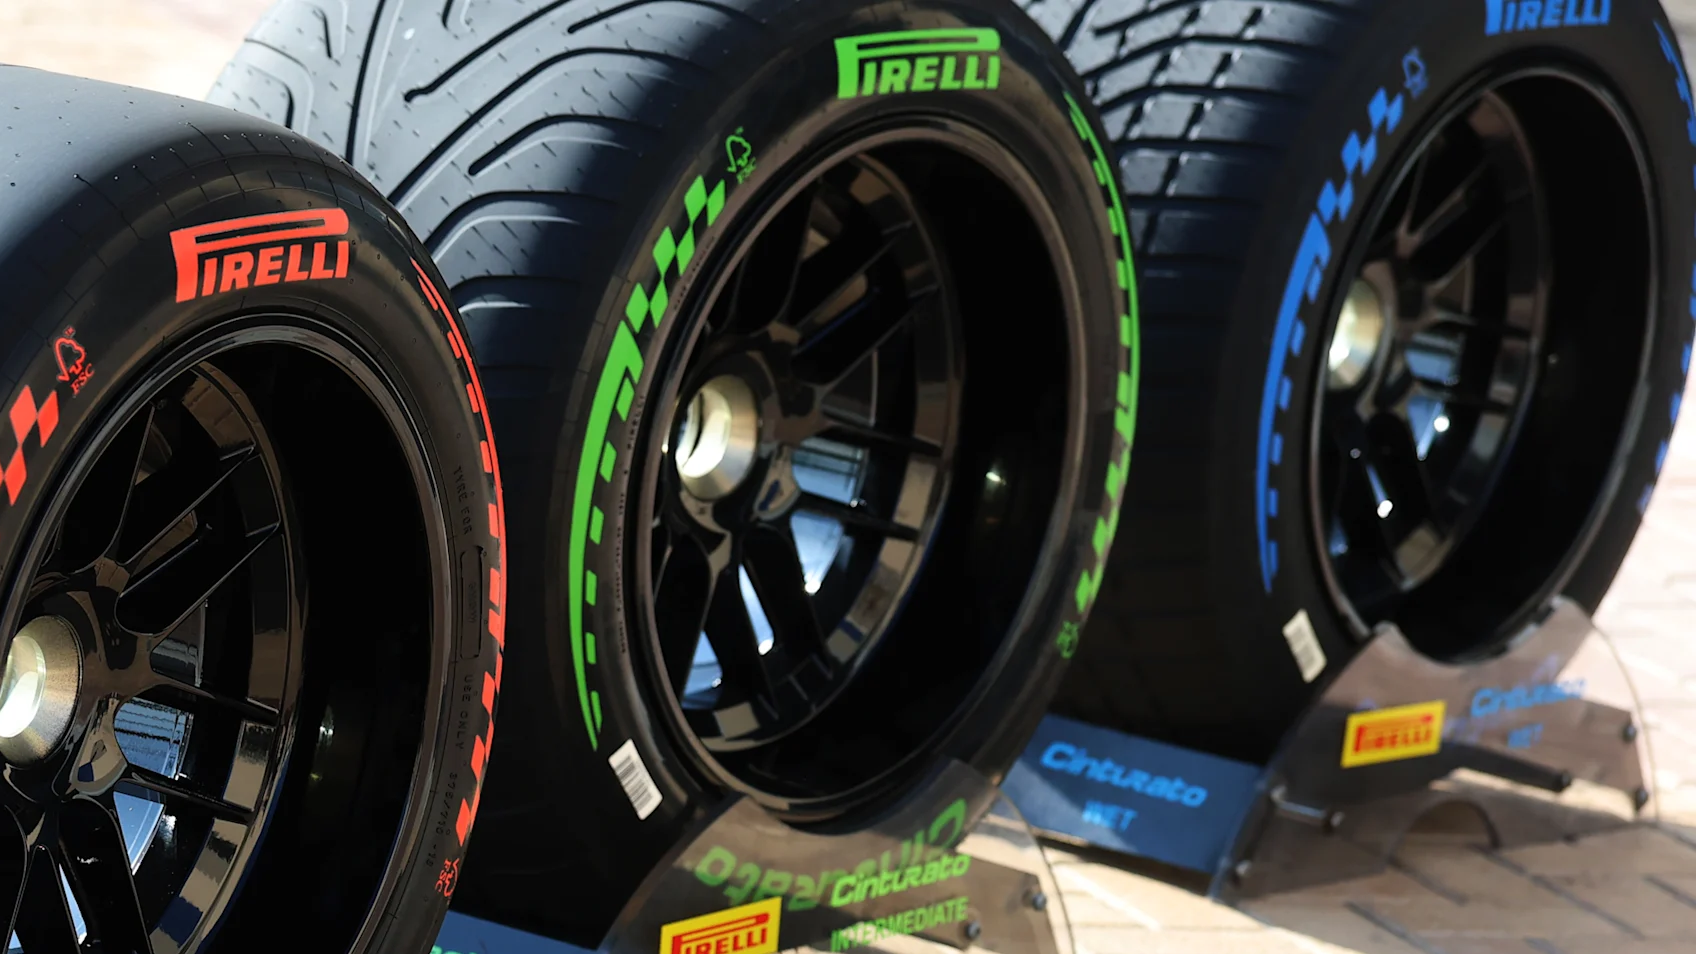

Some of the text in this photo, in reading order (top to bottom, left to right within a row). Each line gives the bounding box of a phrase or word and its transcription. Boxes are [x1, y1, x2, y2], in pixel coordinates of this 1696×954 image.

[834, 27, 1001, 99] PIRELLI
[169, 207, 349, 303] PIRELLI
[70, 363, 95, 396] FSC
[453, 466, 473, 536] TYRE FOR
[455, 710, 468, 750] ONLY
[434, 858, 452, 893] FSC
[830, 853, 971, 908] Cinturato
[831, 897, 969, 953] INTERMEDIATE
